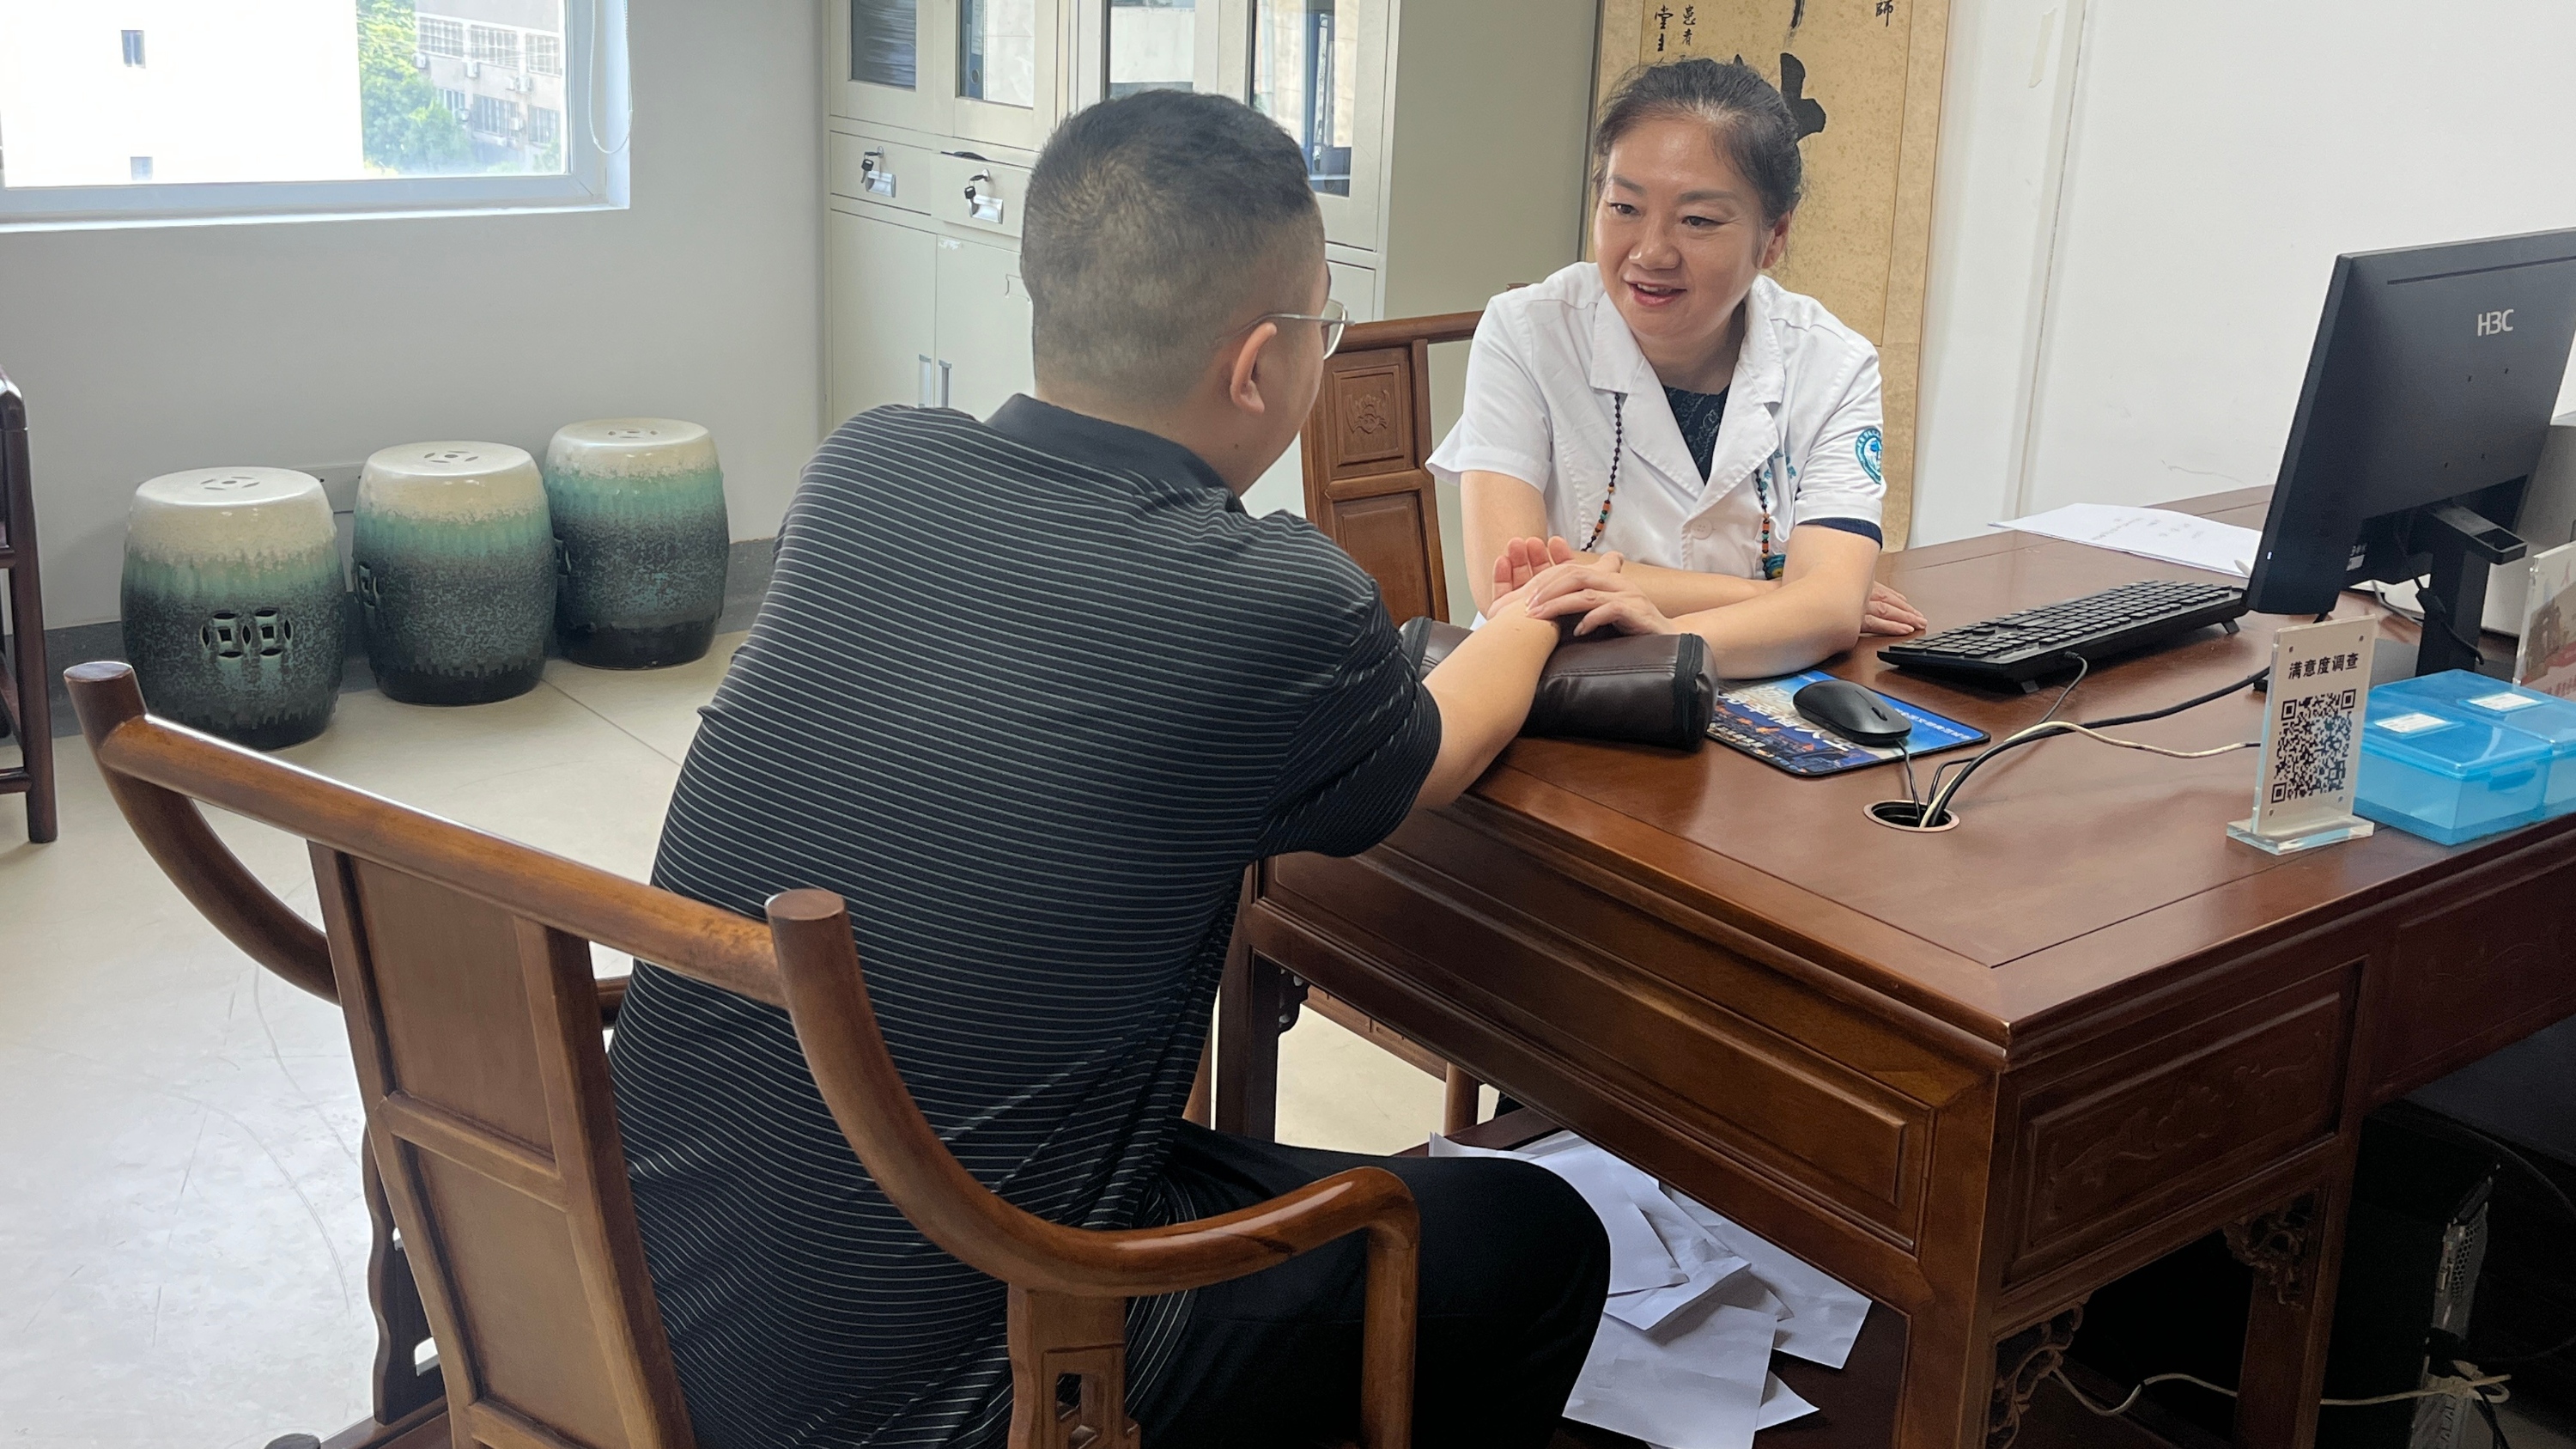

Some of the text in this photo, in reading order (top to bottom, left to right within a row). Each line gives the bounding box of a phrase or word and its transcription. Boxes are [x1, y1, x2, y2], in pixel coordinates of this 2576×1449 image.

[1655, 4, 1674, 65] 堂主
[1680, 4, 1697, 62] 患者
[2477, 308, 2514, 336] H3C
[2288, 653, 2359, 679] 满意度调查
